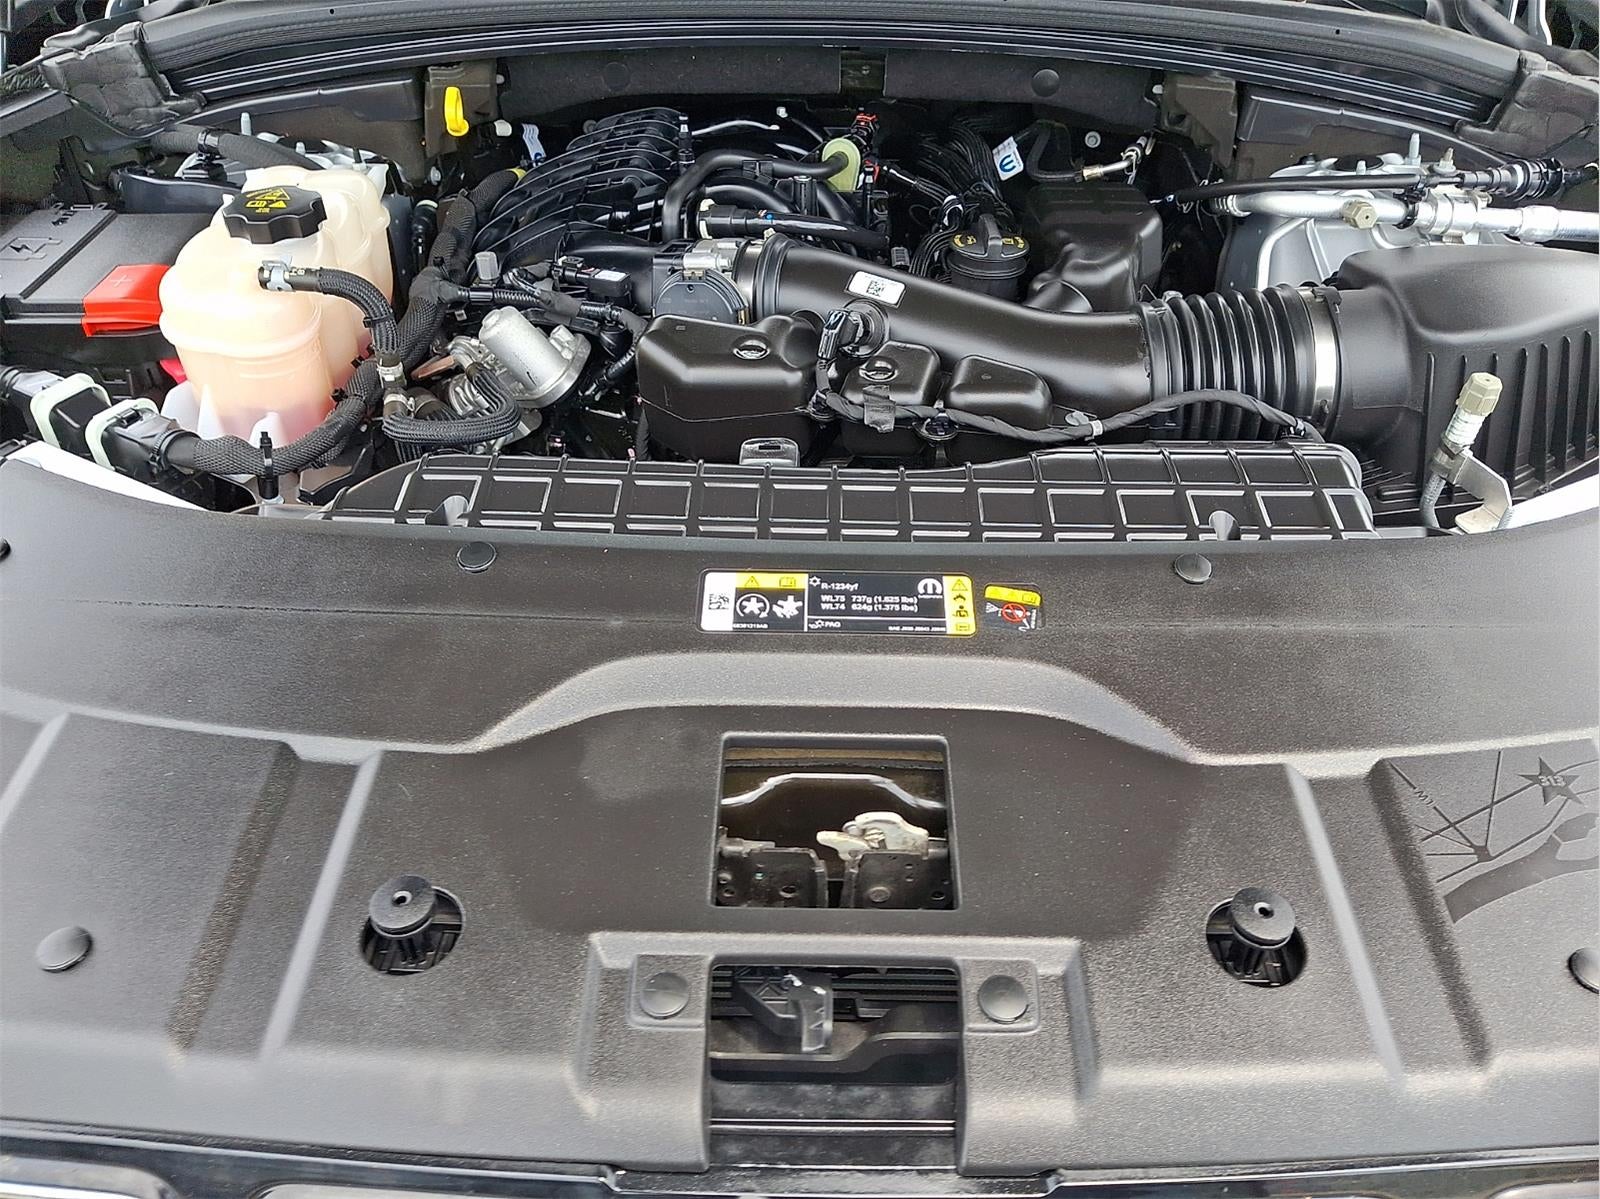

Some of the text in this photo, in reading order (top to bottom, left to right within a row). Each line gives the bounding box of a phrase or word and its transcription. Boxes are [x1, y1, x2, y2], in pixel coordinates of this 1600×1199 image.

[821, 582, 859, 592] R-1234yf
[820, 594, 846, 602] WL75
[851, 595, 872, 604] 737g
[901, 596, 918, 604] lbs)
[820, 602, 846, 610] WL74
[851, 603, 873, 611] 624g
[901, 604, 918, 612] lbs)
[1538, 775, 1566, 788] 313
